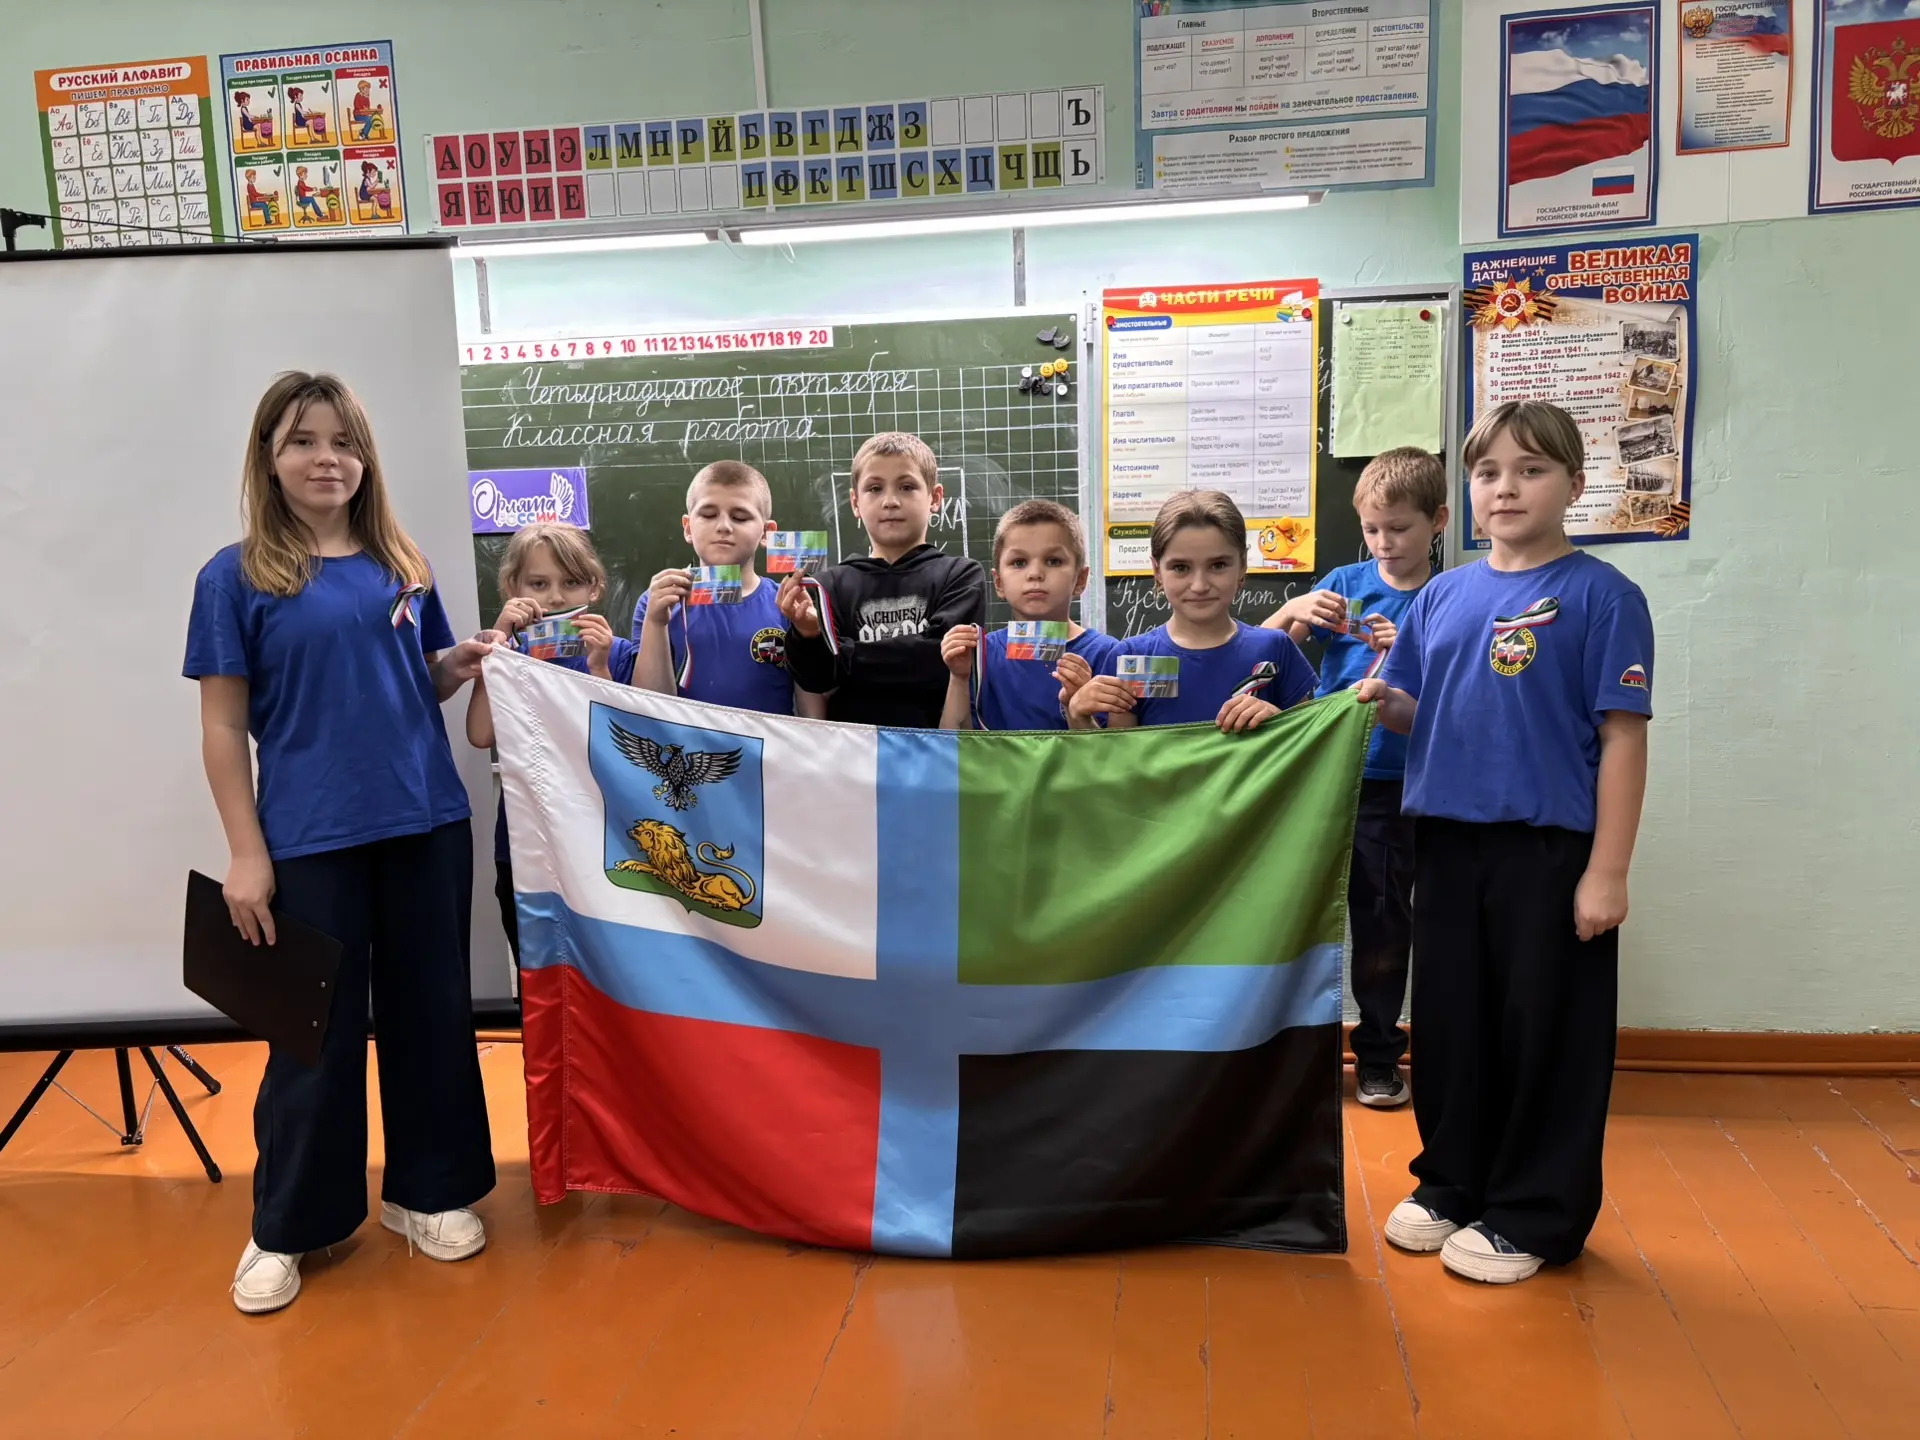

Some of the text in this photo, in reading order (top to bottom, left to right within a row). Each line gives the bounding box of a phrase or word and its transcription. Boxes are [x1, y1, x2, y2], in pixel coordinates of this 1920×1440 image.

[1315, 27, 1357, 38] ОПРЕДЕЛЕНИЕ
[1372, 22, 1424, 32] ОБСТОЯТЕЛЬСТВО
[1201, 38, 1234, 47] СКАЗУЕМОЕ
[1256, 32, 1294, 42] ДОПОЛНЕНИЕ
[1146, 42, 1186, 52] ПОДЛЕЖАЩЕЕ
[235, 48, 379, 72] ПРАВИЛЬНАЯ ОСАНКА
[58, 66, 183, 88] РУССКИЙ АЛФАВИТ
[71, 85, 169, 100] ПИШЕМ ПРАВИЛЬНО
[1151, 110, 1178, 119] Завтра
[1186, 106, 1233, 116] родителями
[1234, 104, 1248, 112] мы
[1248, 102, 1279, 111] пойдём
[1292, 96, 1354, 108] замечательное
[1851, 178, 1917, 190] ГОСУДАРСТВЕННЫЙ
[1848, 188, 1892, 198] РОССИЙСКОЙ
[1536, 202, 1600, 214] ГОСУДАРСТВЕННЫЙ
[1536, 209, 1620, 222] РОССИЙСКОЙ ФЕДЕРАЦИИ
[1472, 255, 1557, 271] ВАЖНЕЙШИЕ
[1568, 244, 1691, 272] ВЕЛИКАЯ
[1472, 270, 1508, 282] ДАТЫ
[1546, 266, 1690, 290] ОТЕЧЕСТВЕННАЯ
[1160, 288, 1276, 306] ЧАСТИ РЕЧИ
[1604, 281, 1690, 304] ВОЙНА
[466, 330, 828, 361] 1 2 3 4 5 6 7 8 9 10 11 12 13 14 15 16 17 18 19 20
[1529, 348, 1539, 356] 23
[1564, 346, 1581, 354] 1941
[1112, 352, 1127, 360] Имя
[1112, 360, 1174, 369] существительное
[1496, 364, 1532, 373] сентября
[1534, 362, 1551, 370] 1941
[1112, 381, 1183, 391] Имя прилагательное
[1500, 378, 1532, 388] сентября
[1535, 376, 1551, 384] 1941
[1576, 373, 1602, 382] апреля
[1501, 392, 1532, 402] октября
[1596, 386, 1614, 394] 1942
[1112, 410, 1135, 418] Глагол
[502, 404, 817, 458] Классная работа
[1128, 436, 1176, 444] числительное
[1112, 464, 1160, 472] Местоимение
[473, 479, 557, 523] Орлята
[1113, 528, 1149, 537] Служебные
[1118, 546, 1149, 554] Предлог
